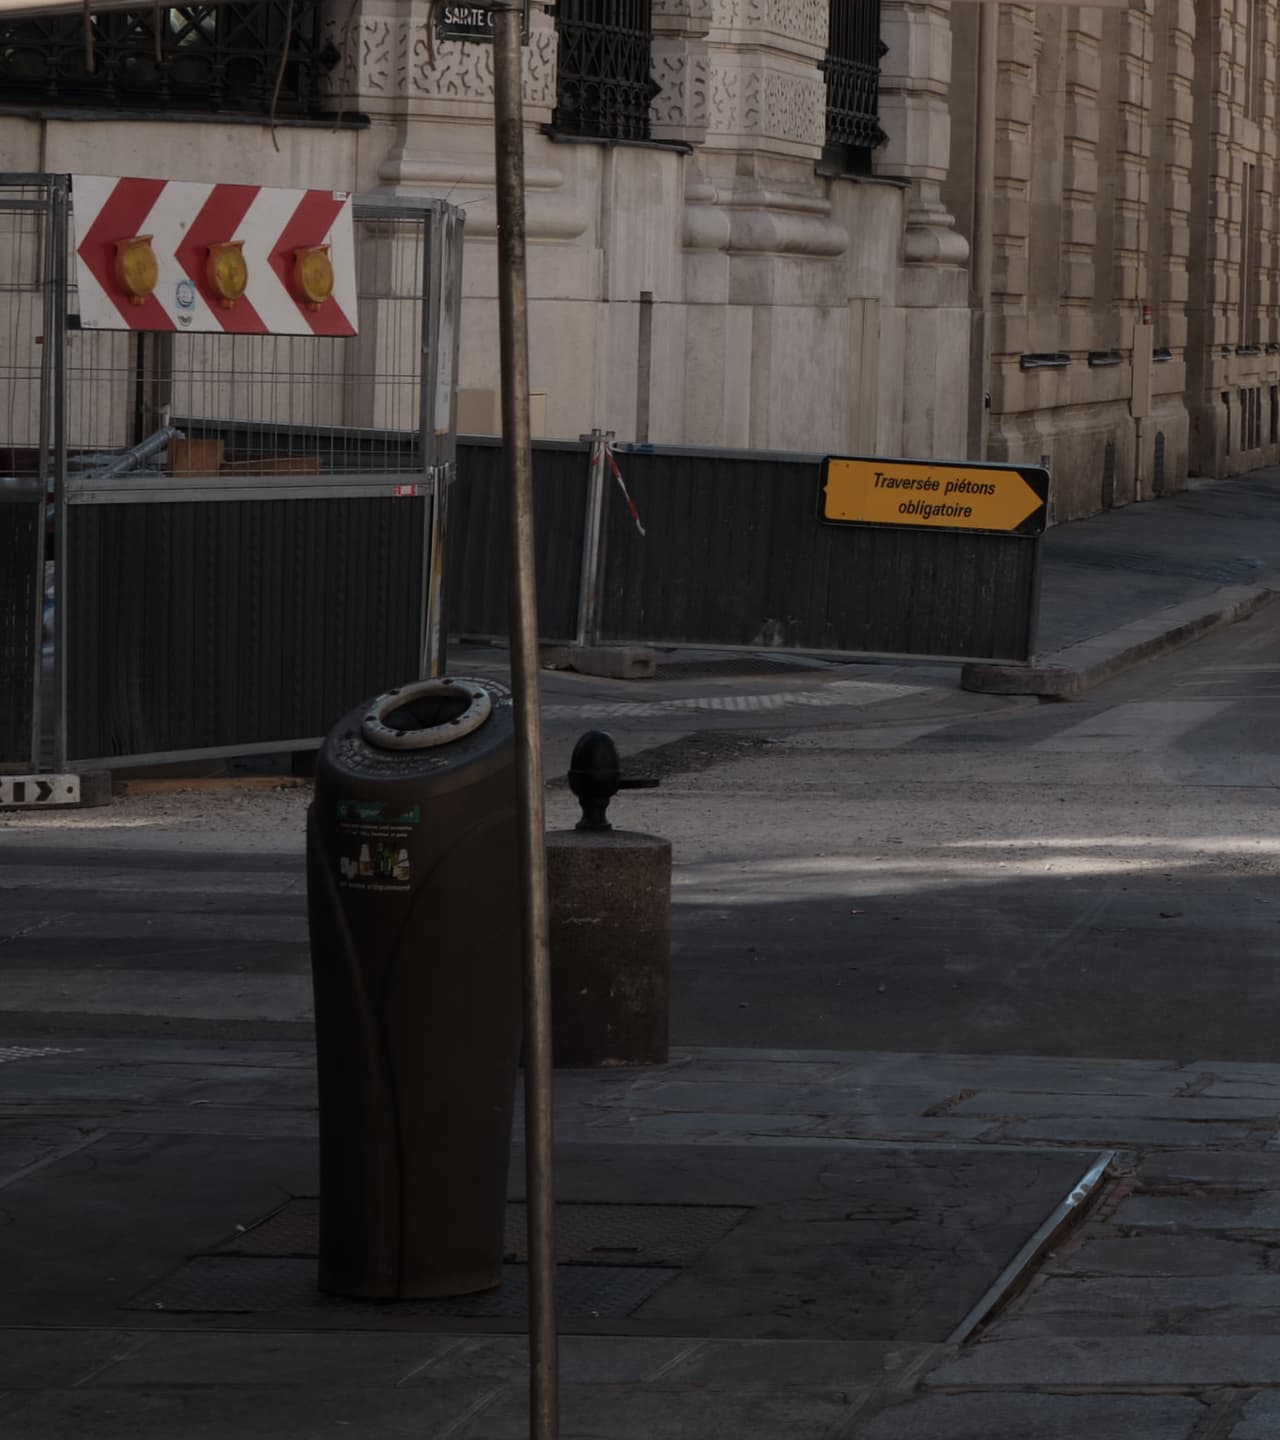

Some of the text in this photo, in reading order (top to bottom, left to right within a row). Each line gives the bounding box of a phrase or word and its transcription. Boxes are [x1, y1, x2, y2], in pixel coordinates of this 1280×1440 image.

[873, 472, 996, 496] Traversée piétons
[898, 500, 973, 520] obligatoire
